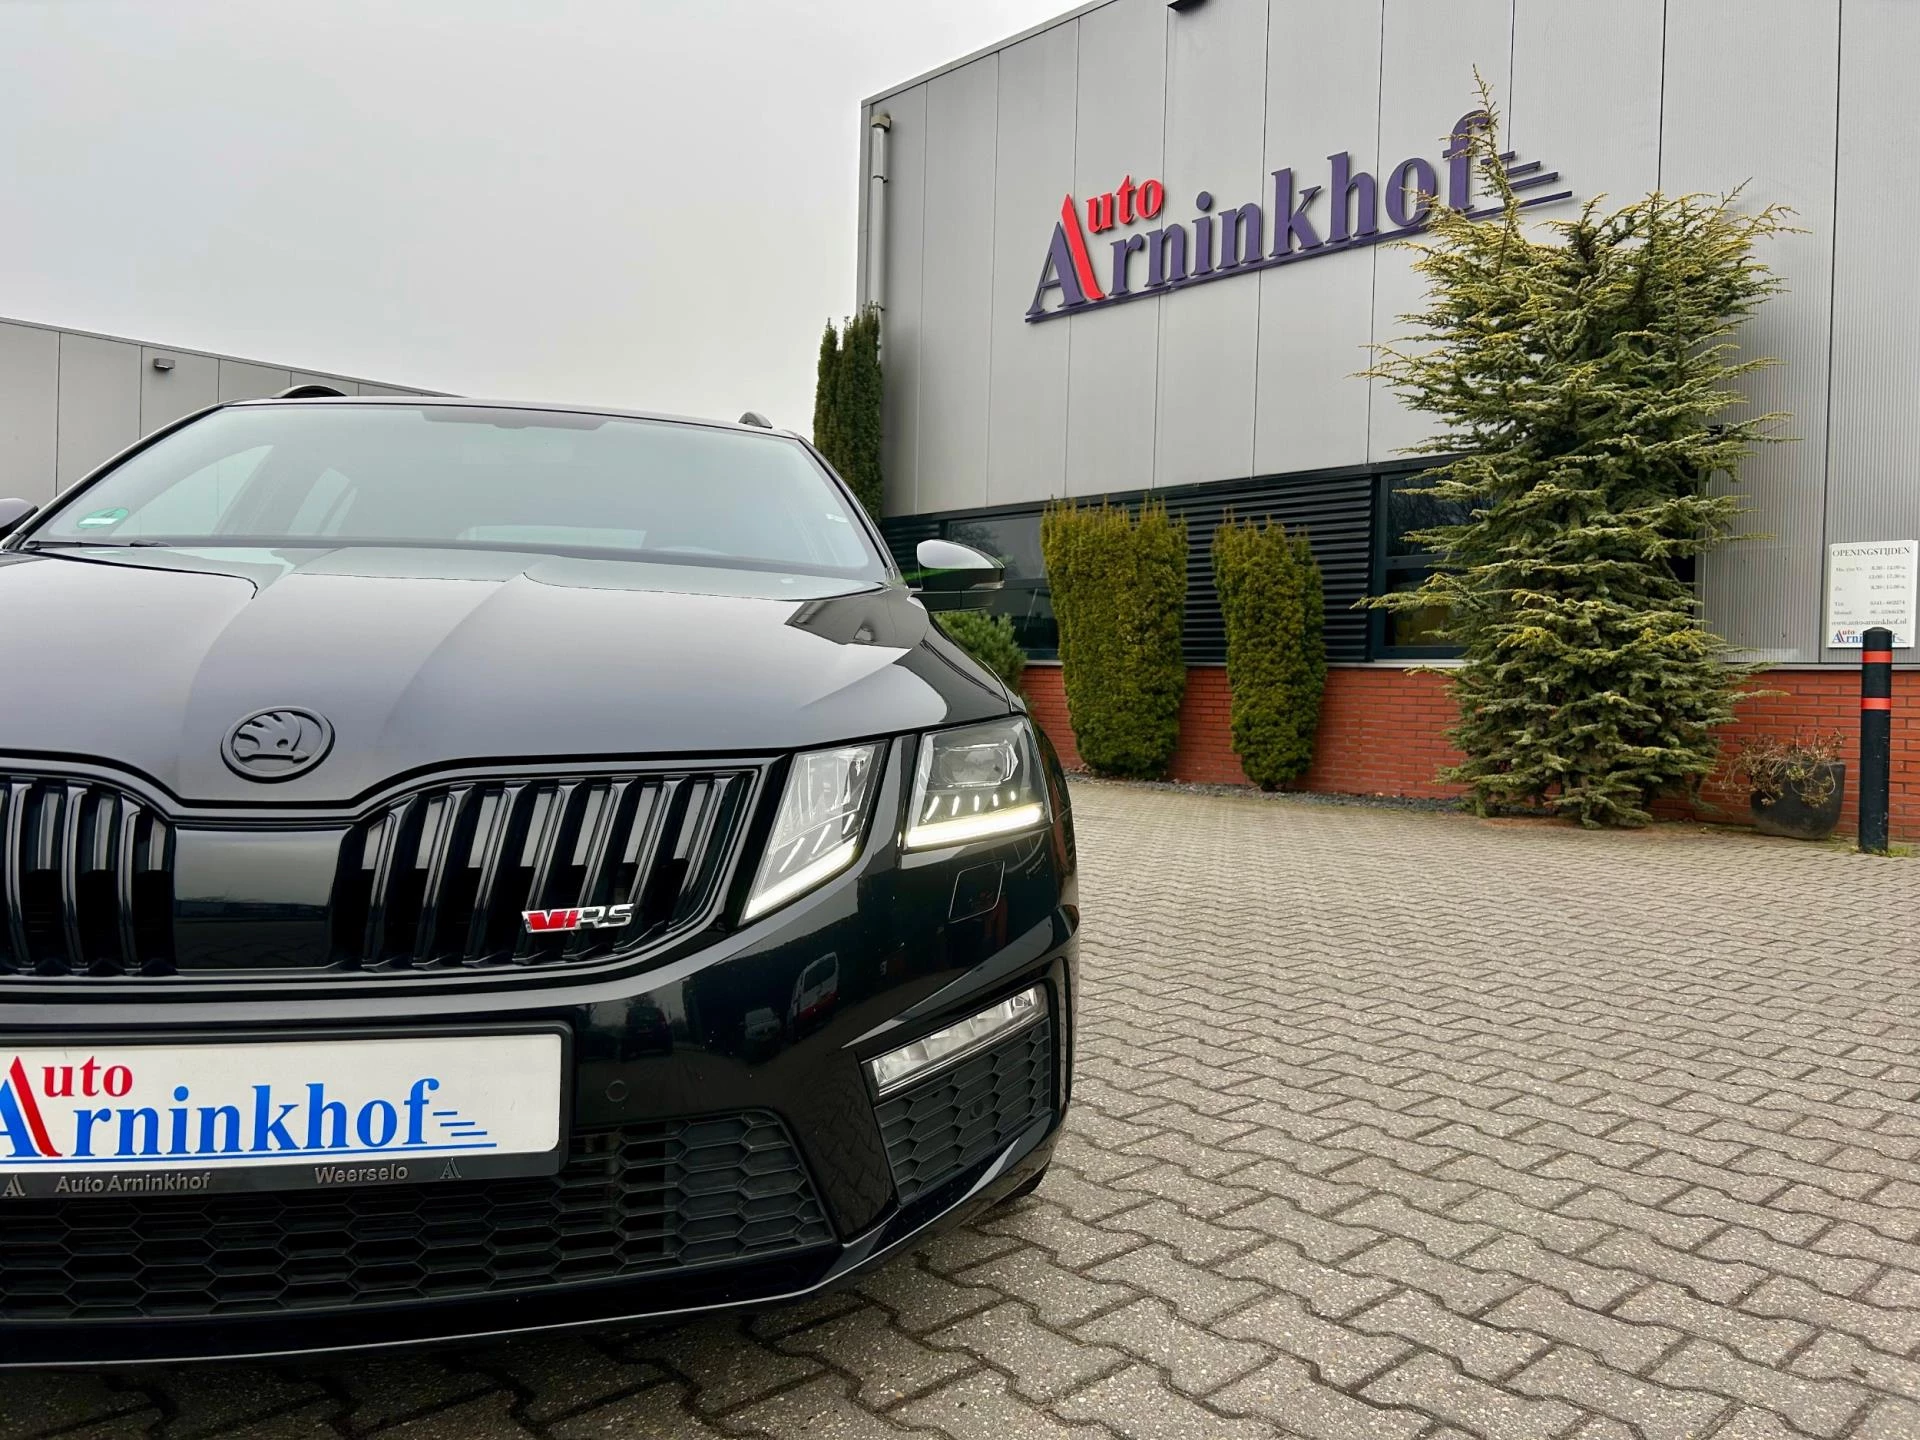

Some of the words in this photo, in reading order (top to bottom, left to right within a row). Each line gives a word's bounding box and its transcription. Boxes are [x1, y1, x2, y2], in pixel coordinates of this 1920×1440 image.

[1026, 109, 1491, 315] Arninkhof
[1832, 547, 1910, 557] OPENINGSTIJDEN
[0, 1078, 440, 1158] Arninkhof
[55, 1175, 104, 1192] Auto
[107, 1172, 210, 1192] Arninkhof
[314, 1163, 409, 1184] Weerselo
